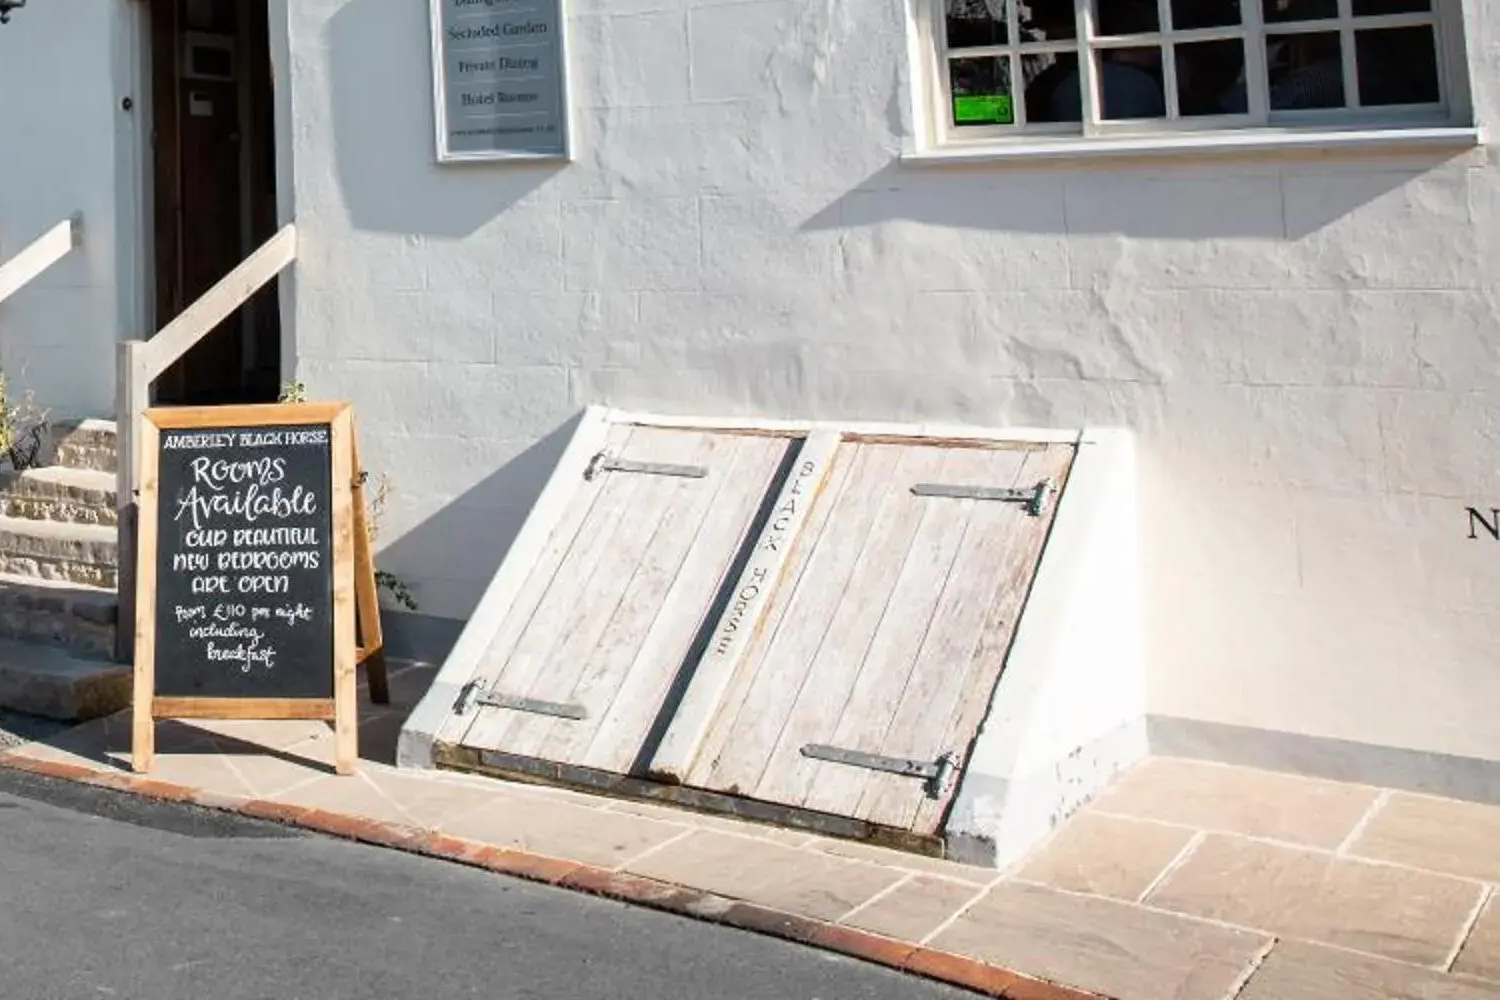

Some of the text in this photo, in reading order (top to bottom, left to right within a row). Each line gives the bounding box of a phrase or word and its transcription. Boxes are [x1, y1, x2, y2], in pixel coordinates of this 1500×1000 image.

[449, 21, 548, 40] Secluded Garden
[459, 57, 539, 74] Private Dining
[461, 93, 495, 106] Hotel
[163, 430, 328, 450] AMBERLEY BLACK HORSE
[174, 484, 317, 528] Available
[213, 604, 246, 620] £110
[252, 606, 271, 622] per
[275, 604, 314, 625] night
[189, 623, 264, 647] including
[207, 644, 277, 672] breakfast
